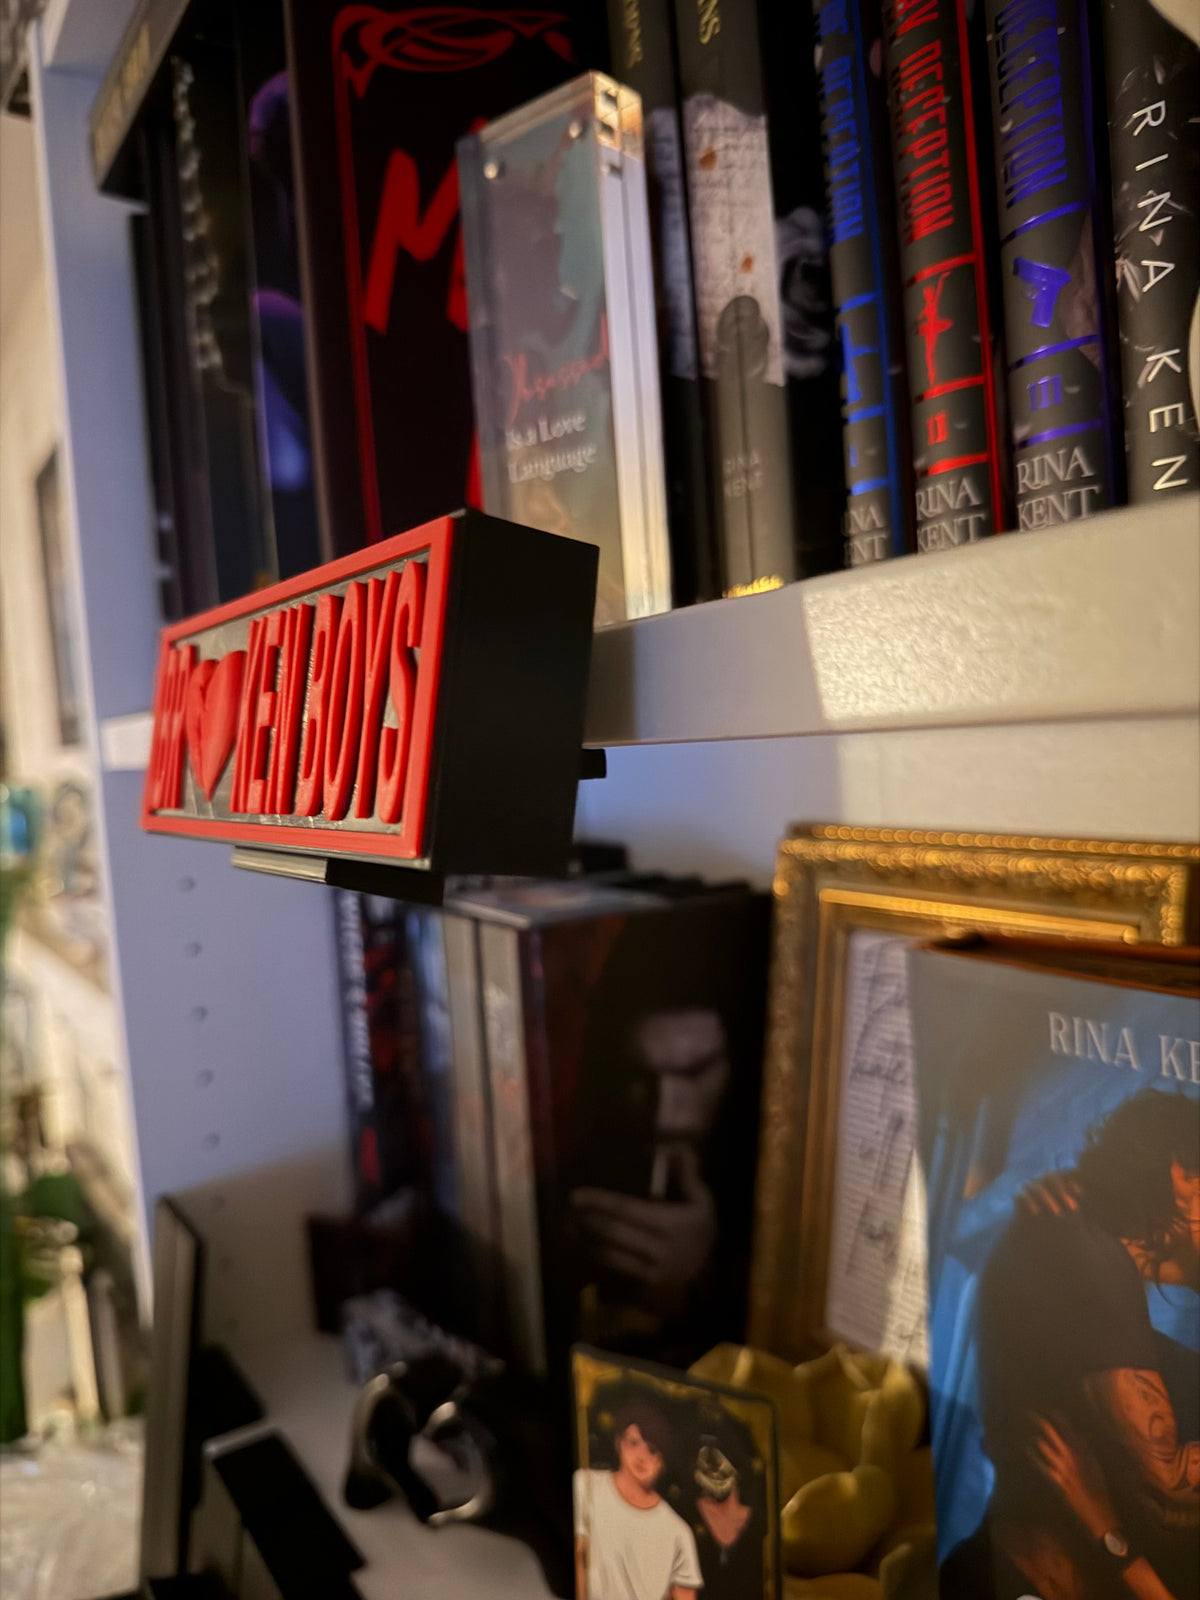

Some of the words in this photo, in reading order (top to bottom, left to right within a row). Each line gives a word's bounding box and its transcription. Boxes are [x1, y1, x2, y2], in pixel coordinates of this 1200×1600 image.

[895, 40, 954, 243] DECEPTION
[1132, 100, 1175, 293] RINA
[1027, 375, 1063, 412] III
[538, 414, 586, 442] Love
[1016, 445, 1095, 494] RINA
[915, 476, 981, 521] RINA
[1017, 485, 1100, 533] KENT
[917, 512, 986, 551] KENT
[295, 560, 427, 825] BOYS
[1048, 1011, 1140, 1072] RINA
